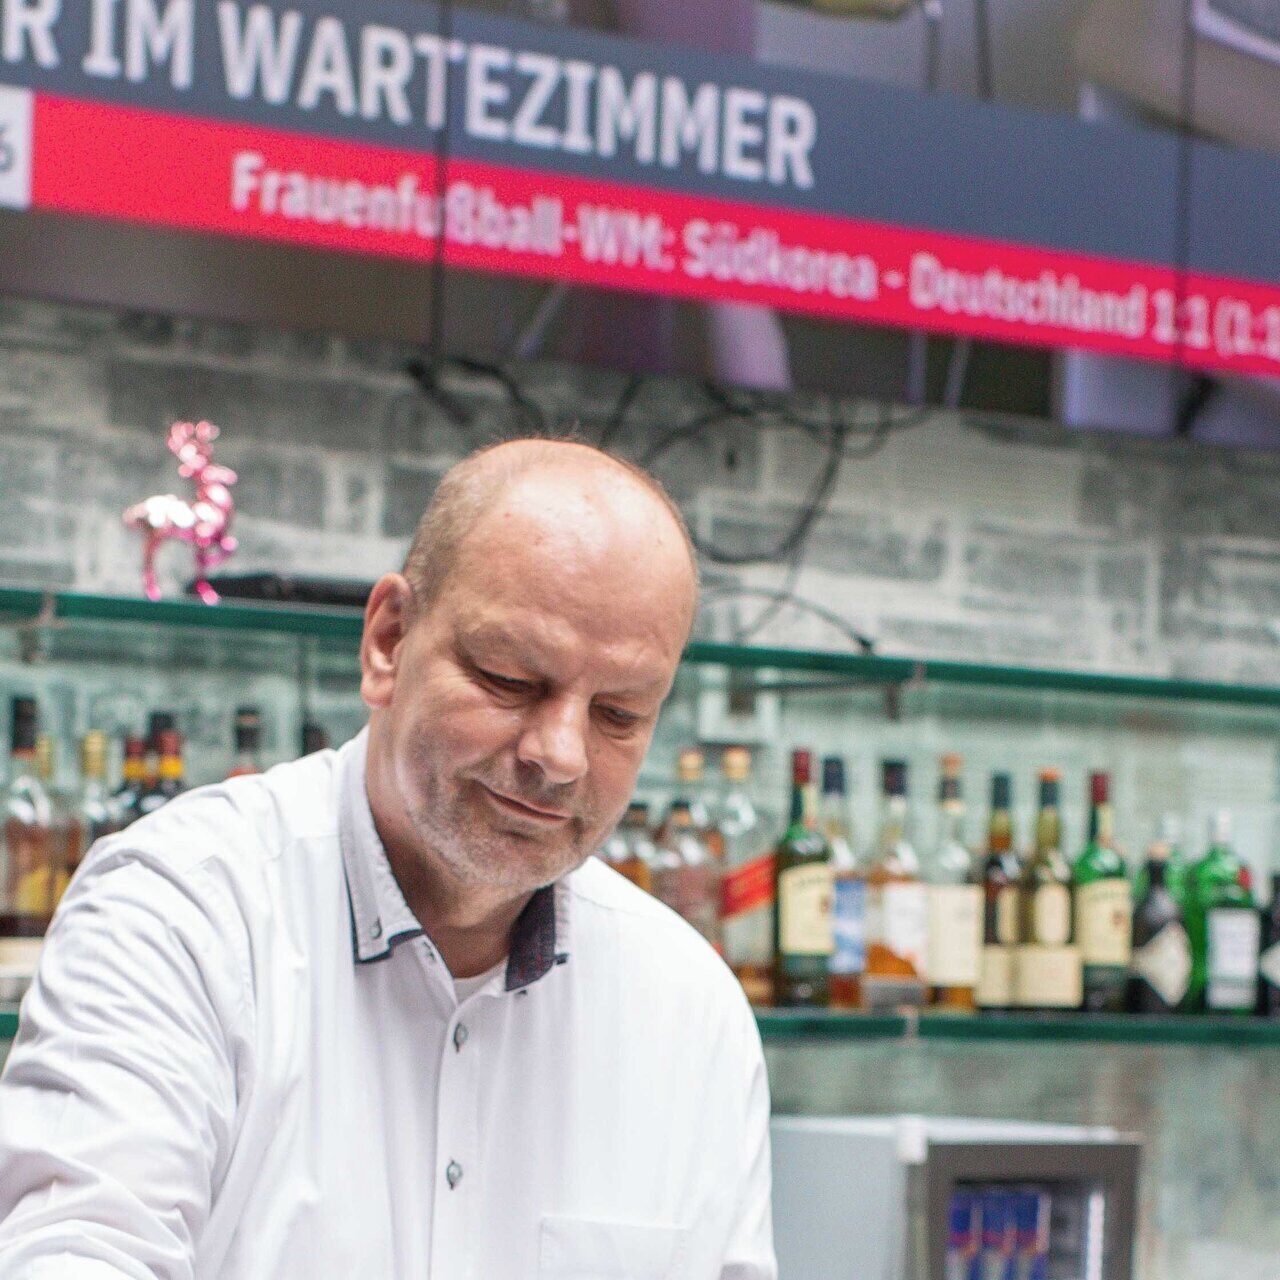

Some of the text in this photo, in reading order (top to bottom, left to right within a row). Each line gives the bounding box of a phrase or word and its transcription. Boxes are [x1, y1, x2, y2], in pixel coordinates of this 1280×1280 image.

[83, 0, 197, 90] IM
[220, 5, 818, 189] WARTEZIMMER
[682, 217, 879, 301] Südkorea
[907, 250, 1149, 339] Deutschland
